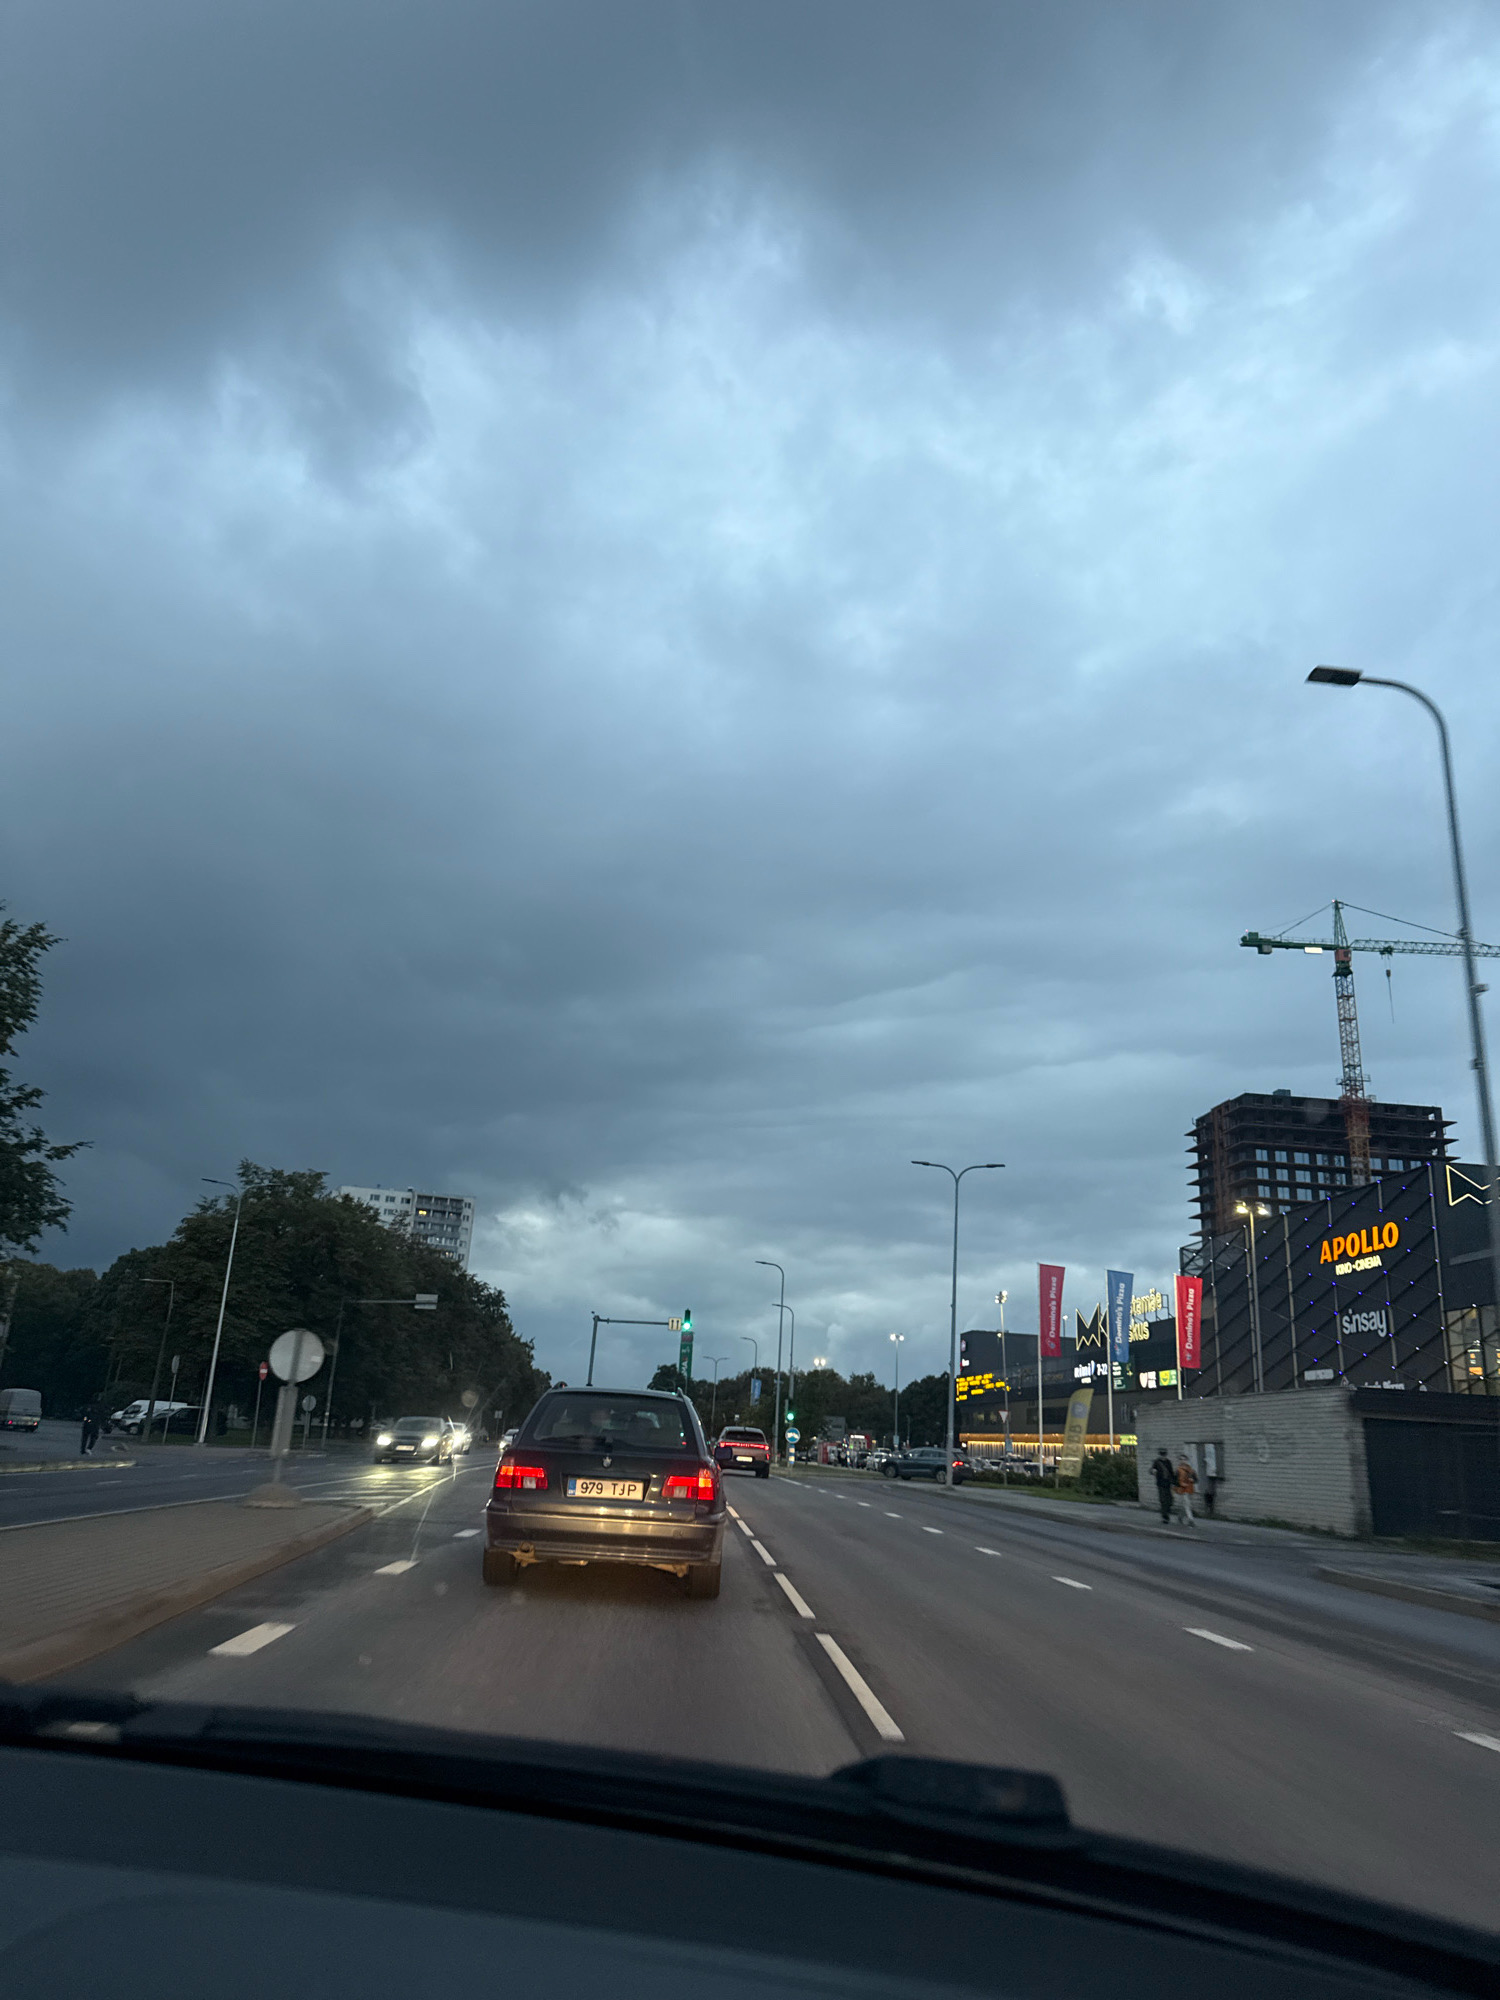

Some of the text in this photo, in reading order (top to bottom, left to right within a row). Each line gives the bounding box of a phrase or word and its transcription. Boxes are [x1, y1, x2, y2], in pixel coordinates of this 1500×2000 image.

[1320, 1221, 1399, 1265] APOLLO
[1048, 1276, 1058, 1338] Domino's Pizza
[1115, 1282, 1126, 1344] Domino's Pizza
[1185, 1288, 1195, 1350] Domino's Pizza
[1342, 1308, 1387, 1338] sinsay
[580, 1481, 604, 1495] 979
[611, 1482, 637, 1496] TJP
